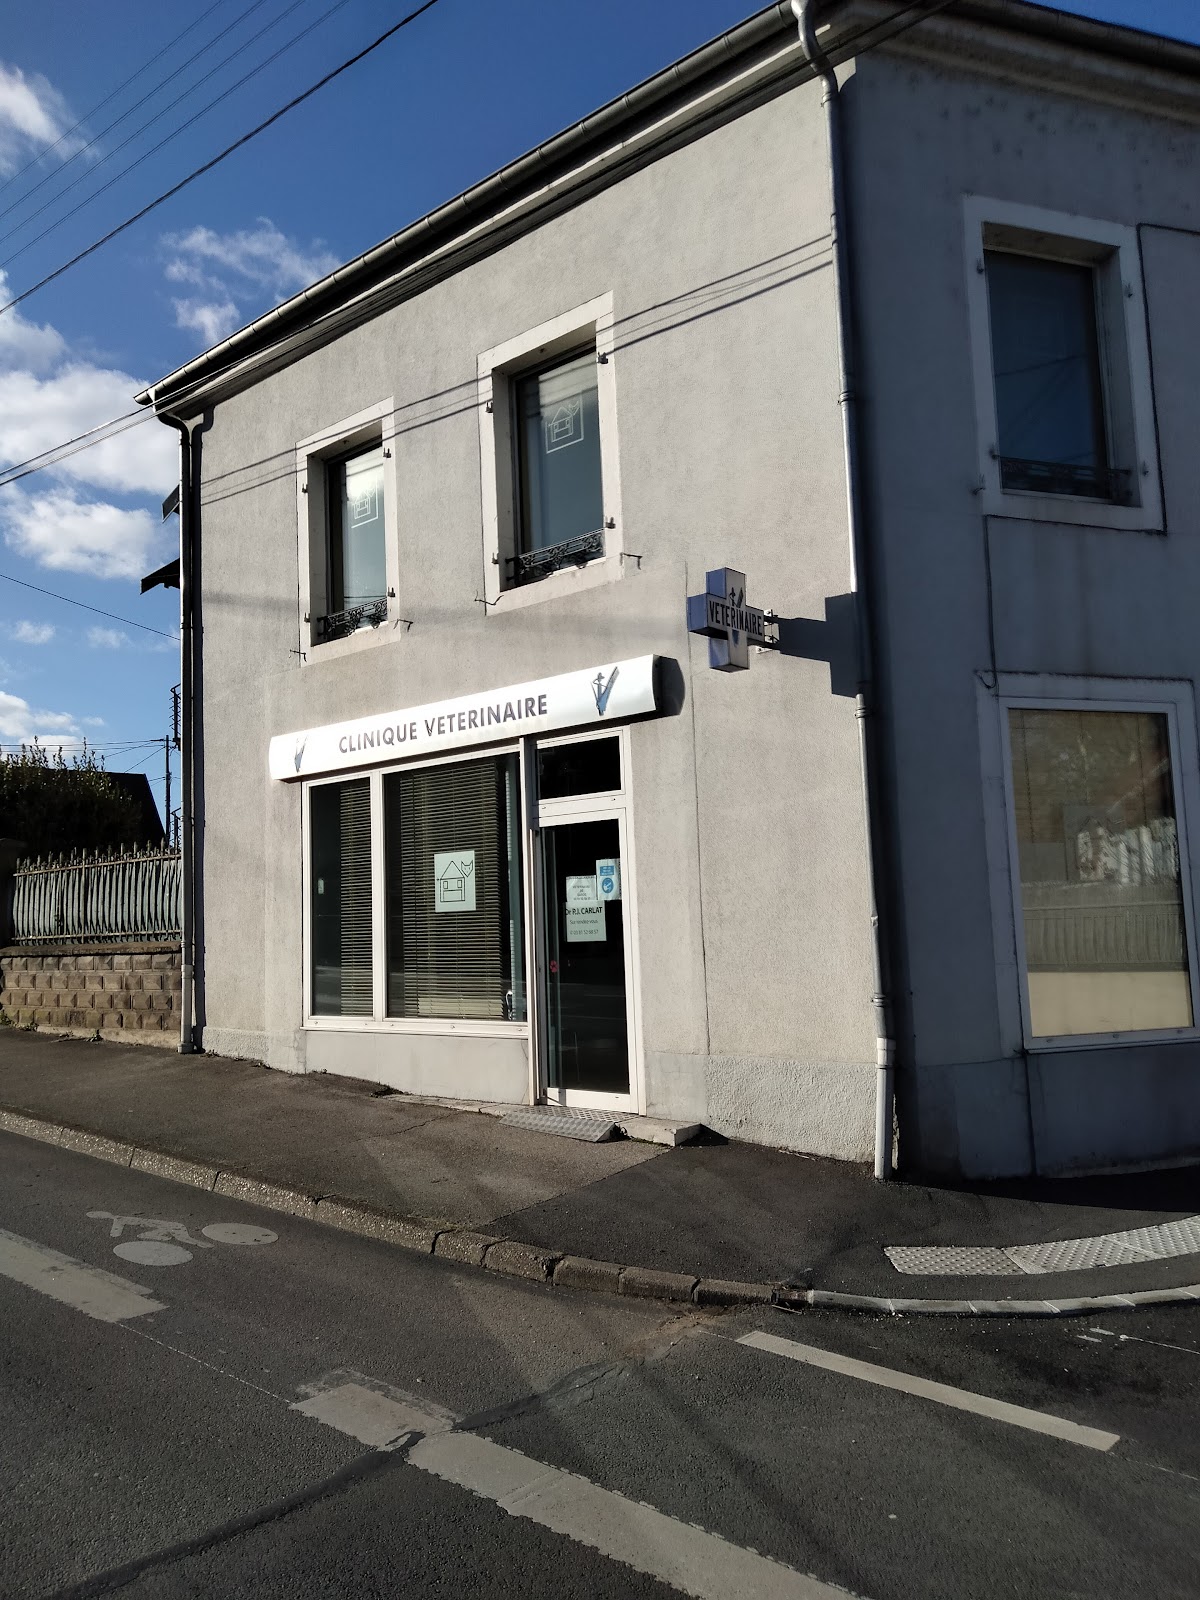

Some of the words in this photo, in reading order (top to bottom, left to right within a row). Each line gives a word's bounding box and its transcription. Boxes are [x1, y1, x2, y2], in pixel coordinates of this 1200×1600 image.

[709, 600, 763, 637] VETERINAIRE
[338, 721, 418, 754] CLINIQUE
[424, 694, 548, 737] VETERINAIRE
[581, 906, 602, 914] CARLAT
